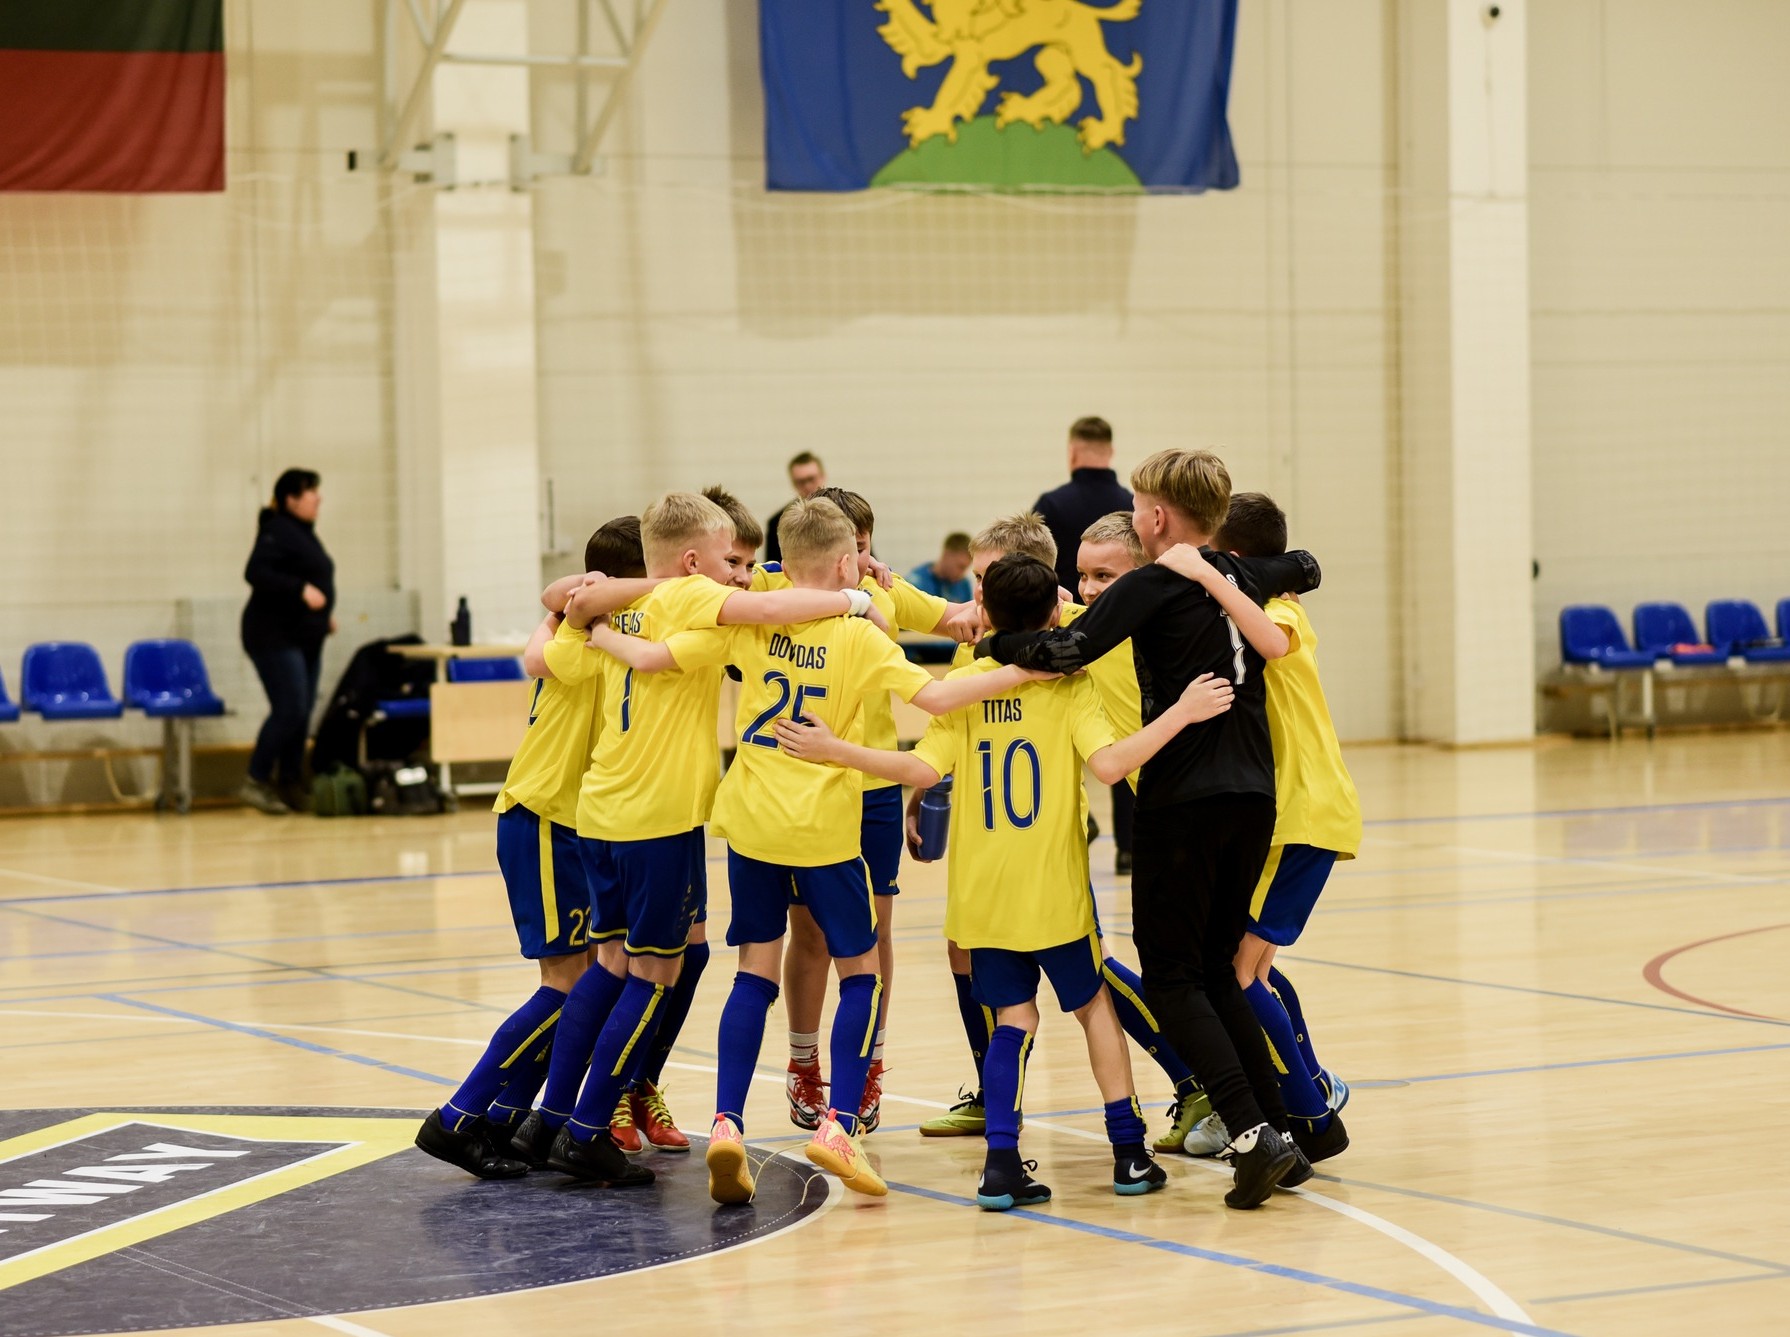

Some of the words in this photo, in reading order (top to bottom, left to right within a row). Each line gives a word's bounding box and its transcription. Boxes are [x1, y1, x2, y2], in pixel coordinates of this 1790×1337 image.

[741, 669, 829, 751] 25
[982, 698, 1022, 723] TITAS
[975, 736, 1043, 832] 10
